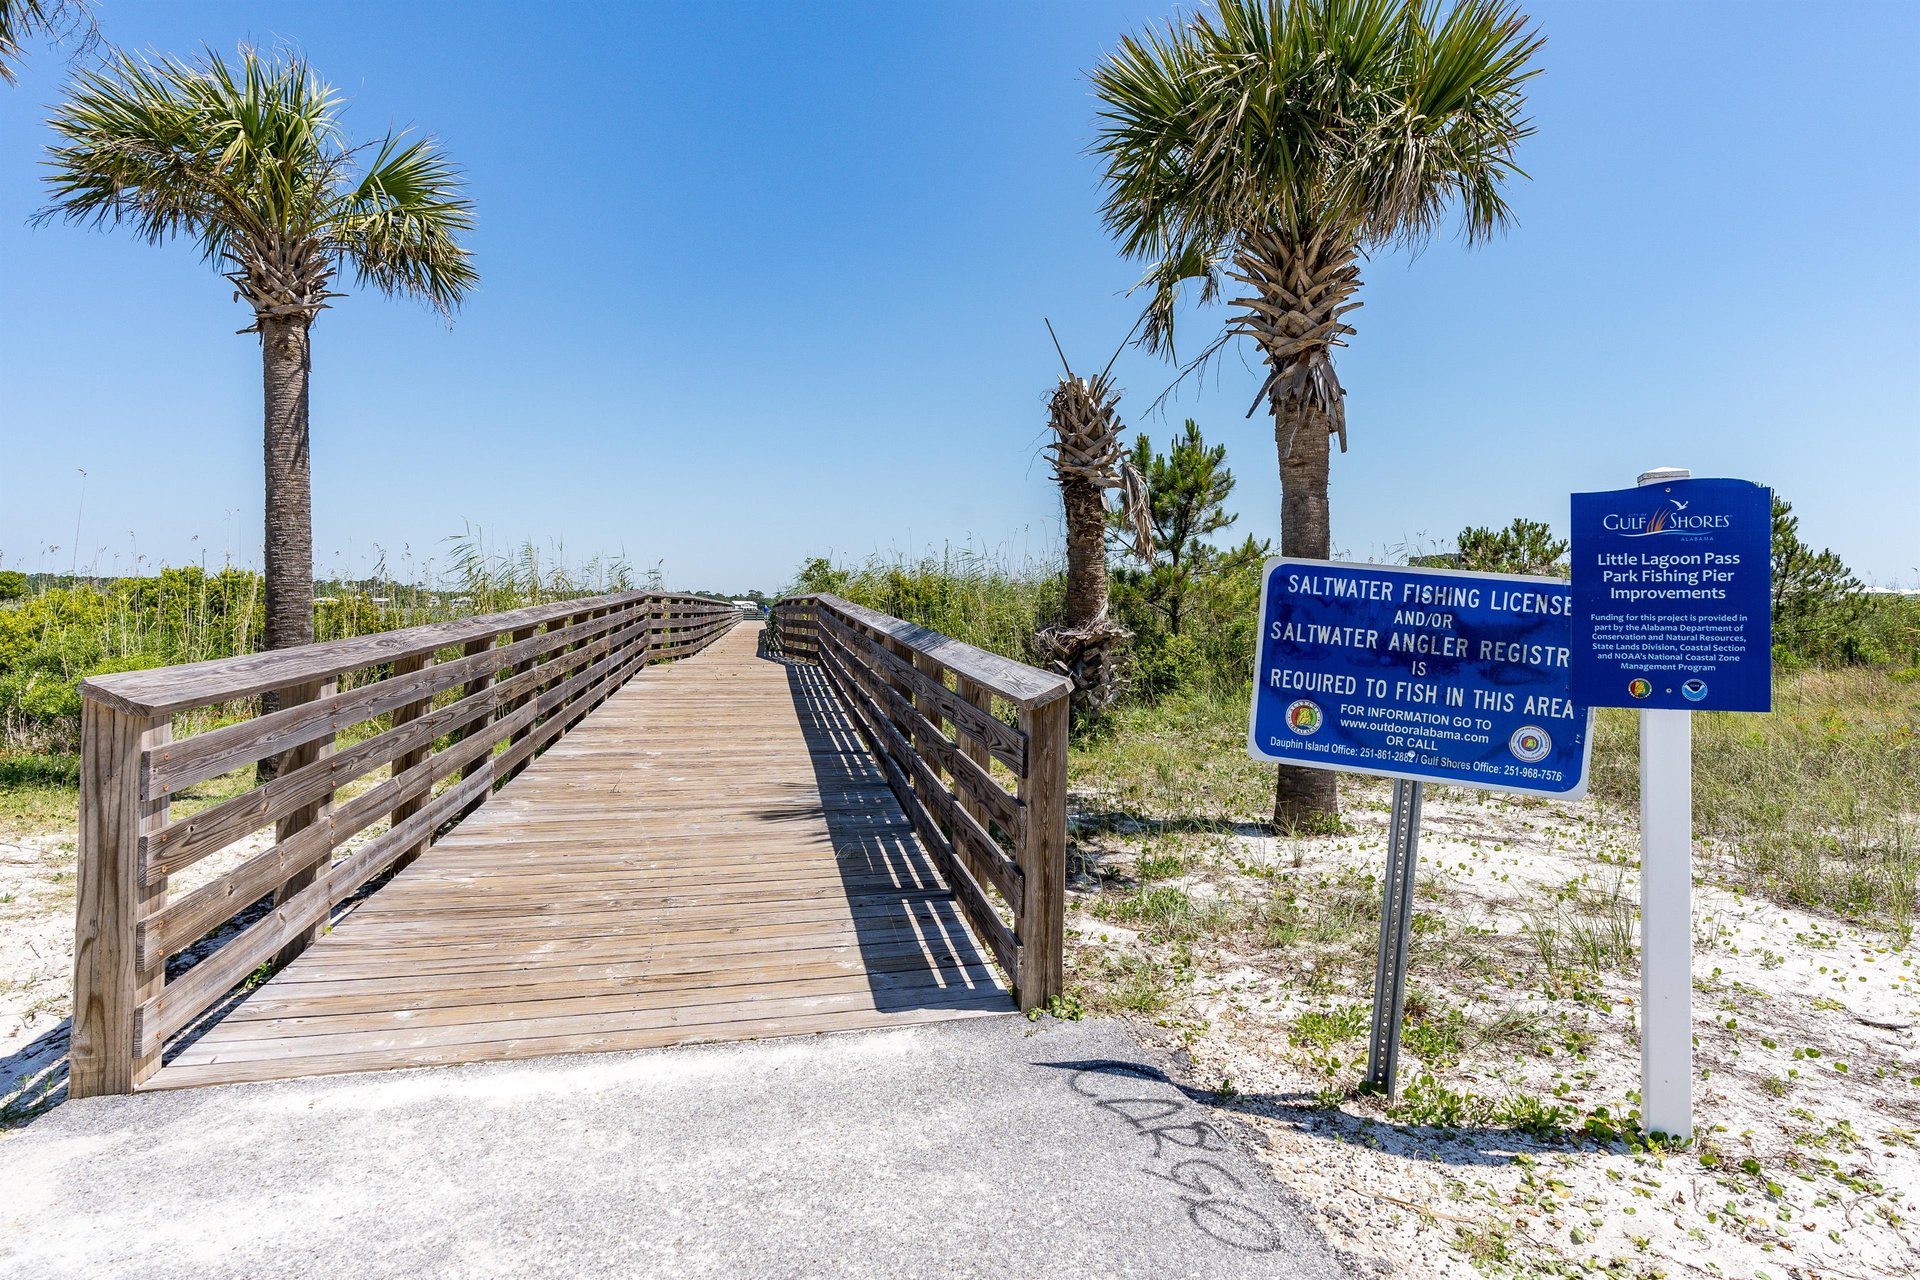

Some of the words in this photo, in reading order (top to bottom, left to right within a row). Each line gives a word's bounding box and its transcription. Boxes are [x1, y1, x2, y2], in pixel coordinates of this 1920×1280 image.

[1603, 514, 1646, 530] GULF
[1670, 512, 1730, 528] SHORES
[1598, 553, 1638, 566] Little
[1642, 553, 1700, 568] Lagoon
[1704, 552, 1740, 564] Pass
[1603, 570, 1638, 582] Park
[1642, 570, 1698, 586] Fishing
[1702, 570, 1734, 582] Pier
[1288, 574, 1392, 601] SALTWATER
[1403, 584, 1480, 608] FISHING
[1490, 590, 1572, 616] LICENSE
[1610, 587, 1726, 602] Improvements
[1394, 610, 1452, 628] AND/OR
[1590, 614, 1624, 622] Funding
[1658, 614, 1688, 622] project
[1698, 614, 1737, 623] provided
[1594, 624, 1612, 632] part
[1614, 624, 1624, 633] by
[1680, 625, 1732, 634] Department
[1270, 621, 1378, 649] SALTWATER
[1388, 632, 1468, 658] ANGLER
[1480, 640, 1570, 668] REGISTR
[1666, 634, 1698, 642] Natural
[1700, 634, 1746, 643] Resources,
[1642, 643, 1678, 652] Division,
[1680, 644, 1711, 652] Coastal
[1412, 661, 1426, 676] IS
[1620, 662, 1676, 672] Management
[1678, 664, 1716, 672] Program
[1270, 668, 1356, 695] REQUIRED
[1366, 678, 1387, 698] TO
[1396, 682, 1438, 704] FISH
[1446, 687, 1464, 707] IN
[1474, 690, 1514, 712] THIS
[1524, 696, 1574, 720] AREA
[1340, 704, 1364, 716] FOR
[1368, 707, 1449, 726] INFORMATION
[1453, 718, 1472, 728] GO
[1476, 719, 1492, 730] TO
[1340, 719, 1489, 744] www.outdooralabama.com
[1386, 736, 1404, 746] OR
[1407, 737, 1438, 751] CALL
[1270, 736, 1302, 750] Dauphin
[1305, 742, 1328, 752] Island
[1332, 744, 1358, 756] Office:
[1420, 754, 1438, 766] Gulf
[1440, 758, 1470, 770] Shores
[1473, 762, 1502, 774] Office:
[1504, 764, 1562, 782] 251-968-7576
